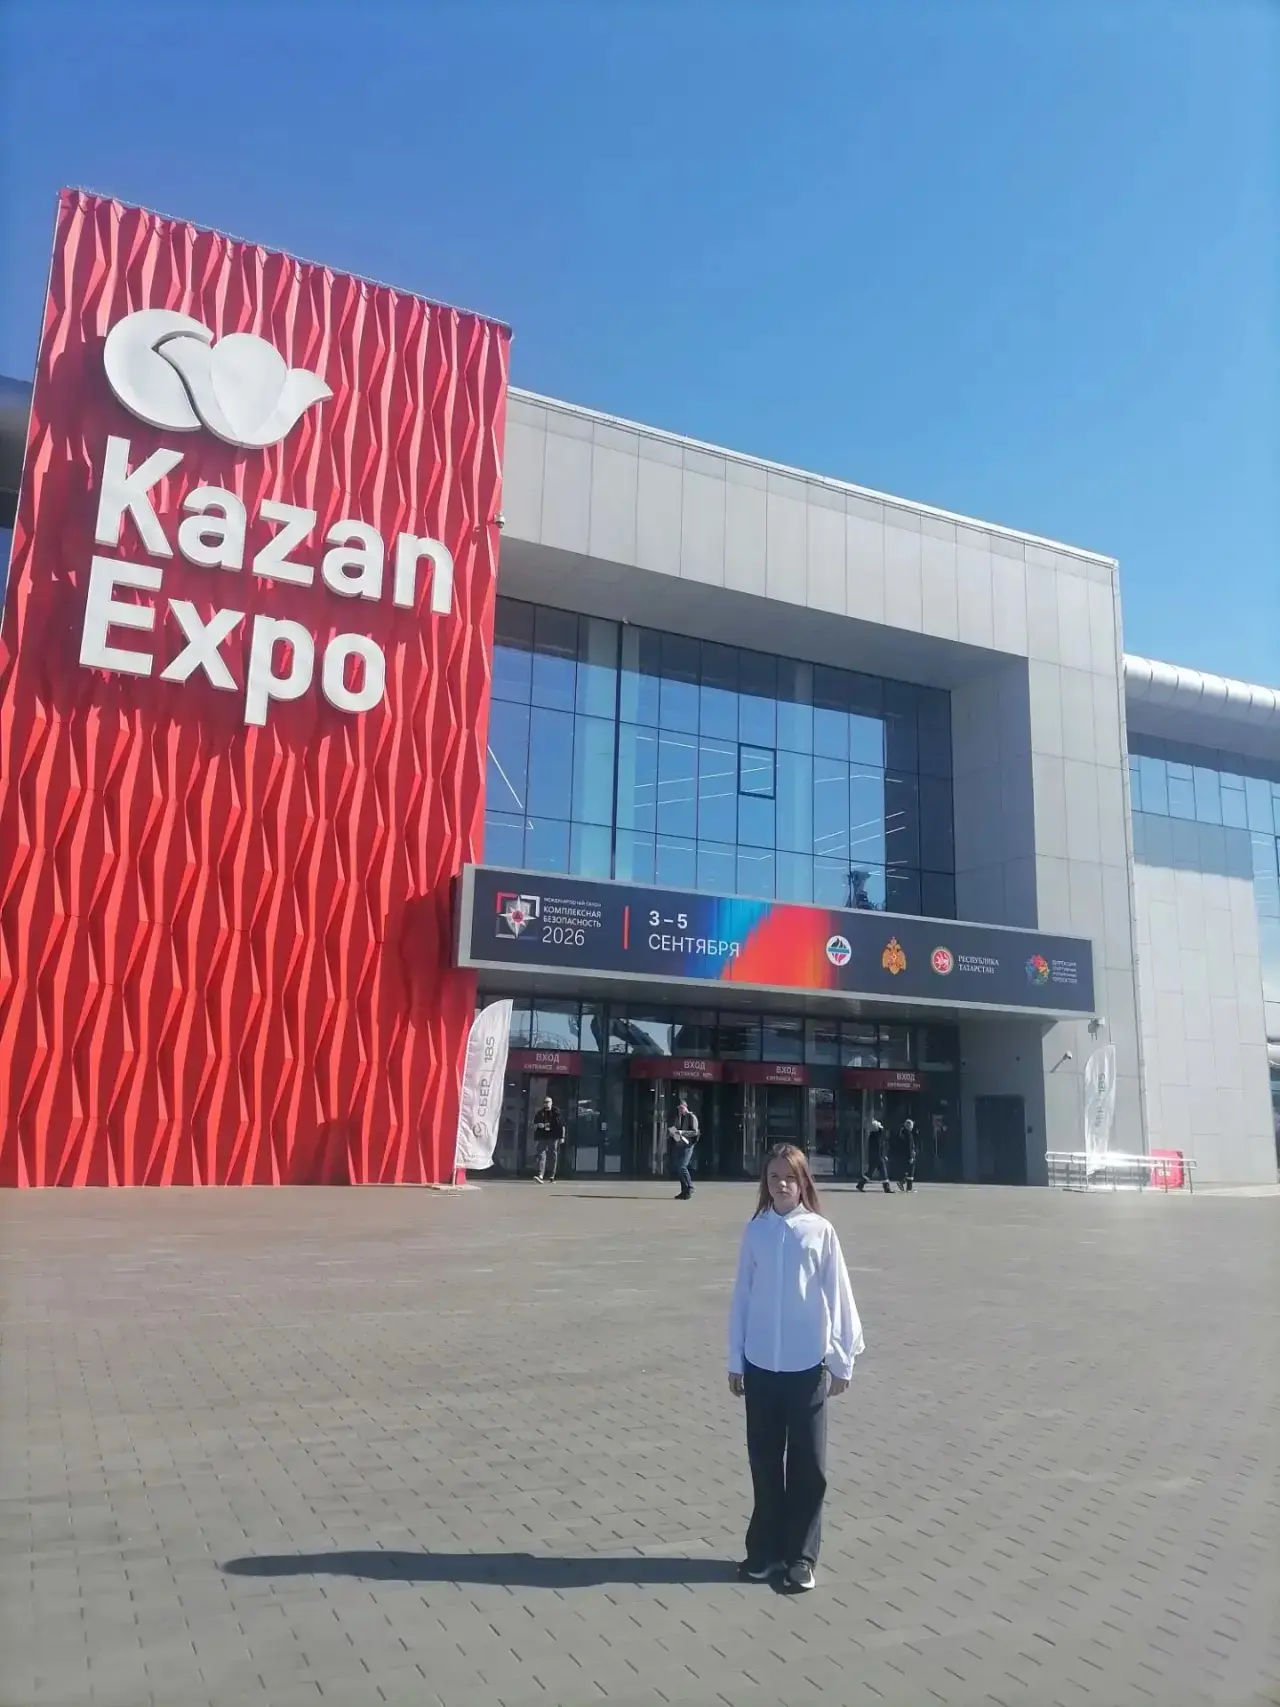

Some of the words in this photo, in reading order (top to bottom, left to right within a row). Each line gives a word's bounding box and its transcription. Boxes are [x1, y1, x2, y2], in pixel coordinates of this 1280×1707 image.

[94, 434, 454, 616] Kazan
[79, 555, 386, 726] Expo
[543, 906, 602, 918] КОМПЛЕКСНАЯ
[543, 915, 602, 928] БЕЗОПАСНОСТЬ
[542, 925, 585, 946] 2026
[648, 933, 740, 958] СЕНТЯБРЯ
[957, 955, 1000, 967] РЕСПУБЛИКА
[958, 964, 995, 974] ТАТАРСТАН
[536, 1053, 560, 1063] ВХОД
[684, 1060, 706, 1070] ВХОД
[776, 1065, 797, 1075] ВХОД
[477, 1078, 491, 1117] СБЕР
[484, 1036, 495, 1064] 185
[896, 1073, 916, 1082] ВХОД
